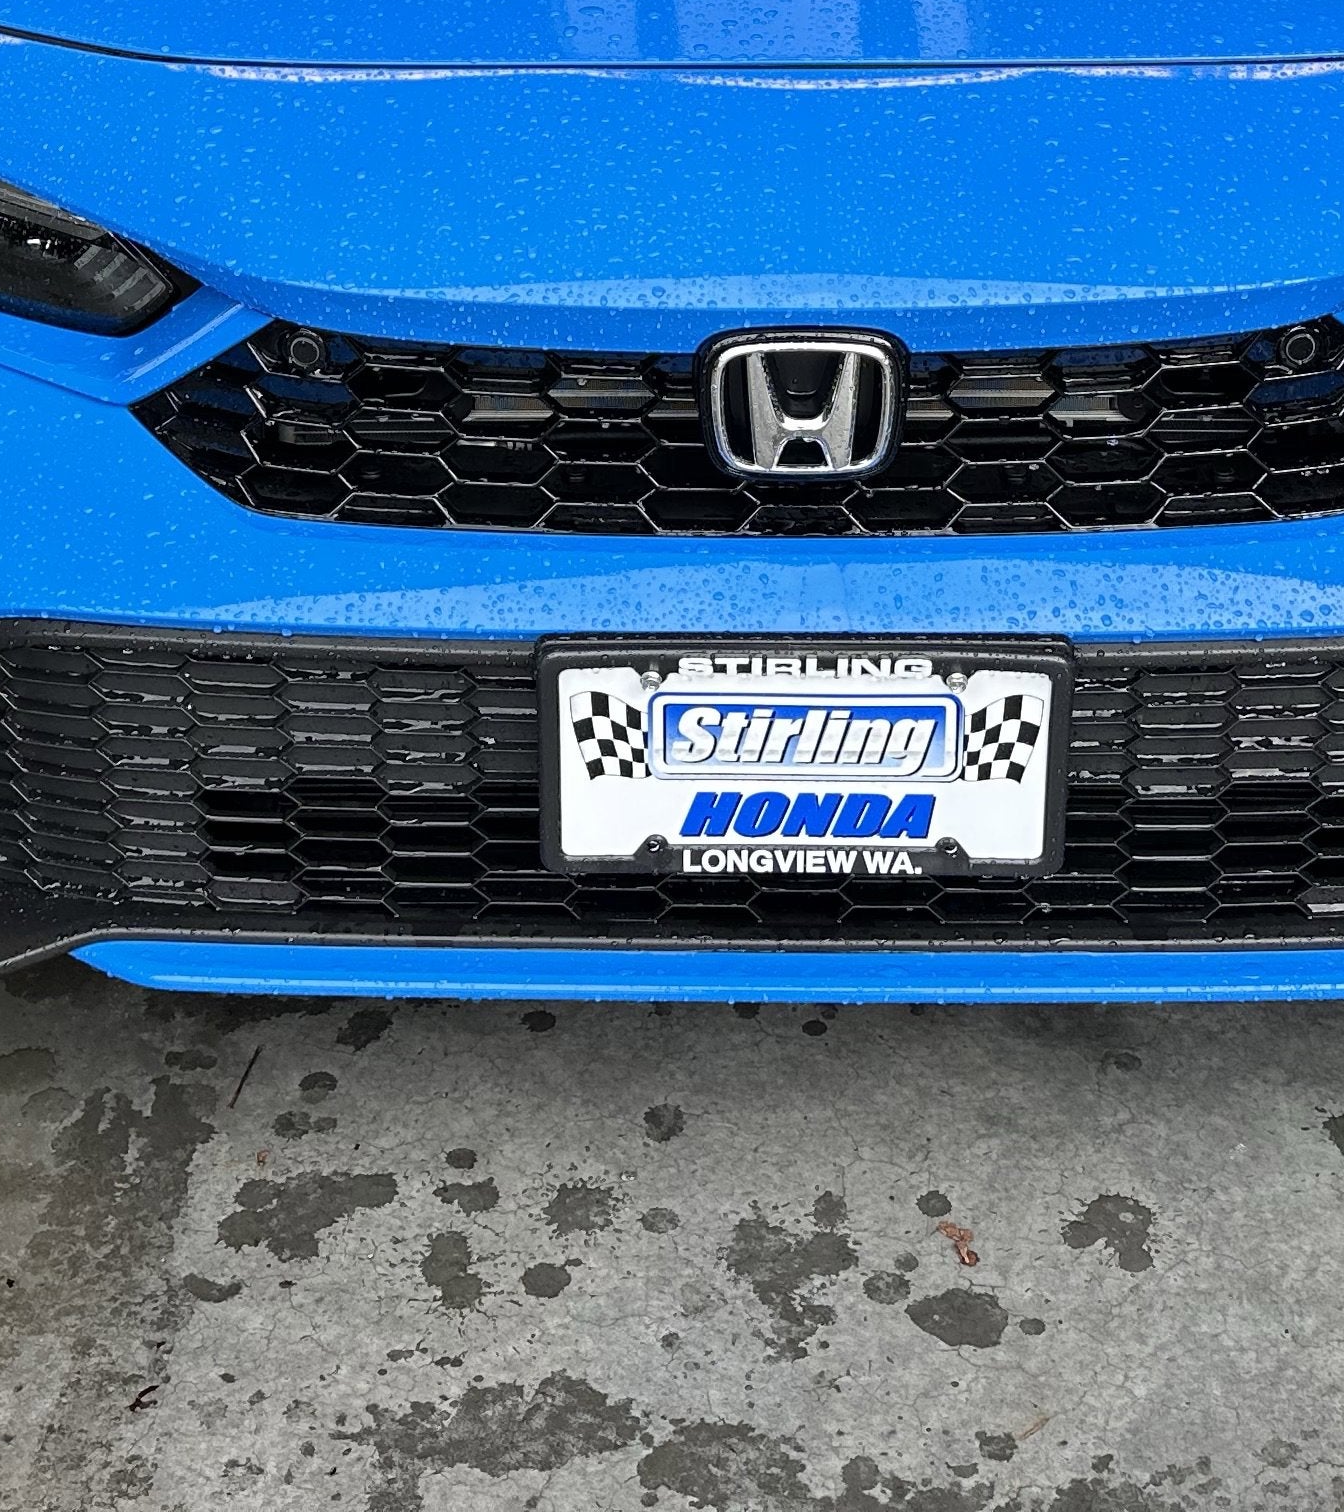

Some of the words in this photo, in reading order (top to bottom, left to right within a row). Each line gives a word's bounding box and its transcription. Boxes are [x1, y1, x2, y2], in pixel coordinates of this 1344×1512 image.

[677, 656, 934, 679] STIRLING
[671, 705, 939, 777] Stirling
[678, 790, 937, 839] HONDA
[682, 848, 858, 875] LONGVIEW
[862, 849, 924, 875] WA.
